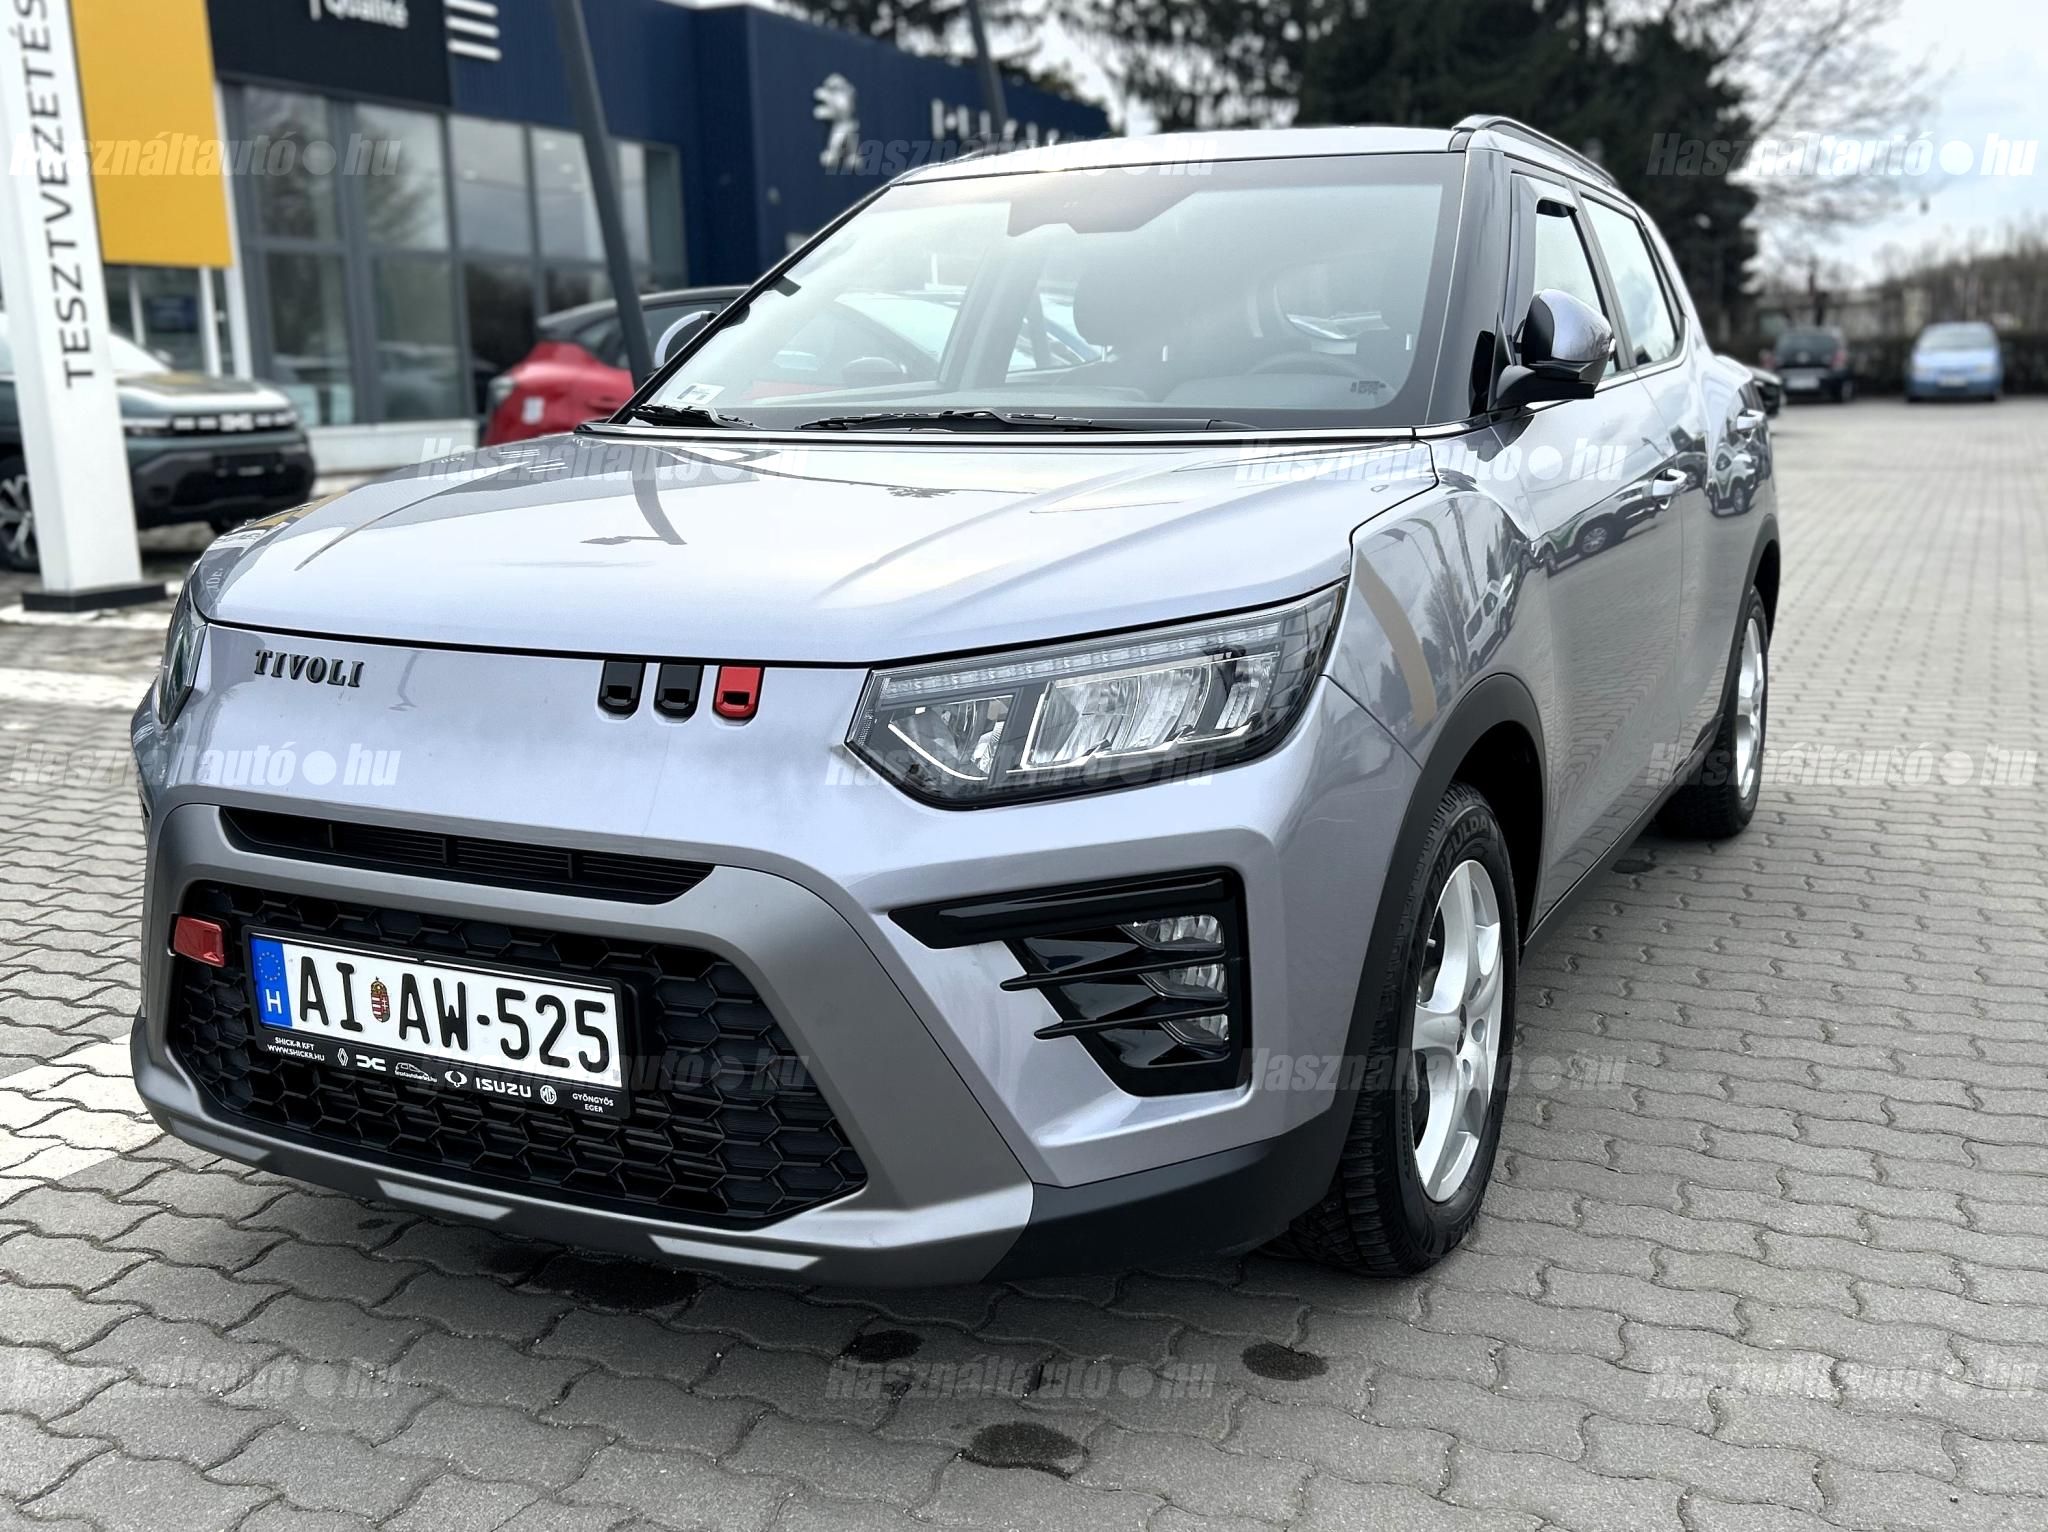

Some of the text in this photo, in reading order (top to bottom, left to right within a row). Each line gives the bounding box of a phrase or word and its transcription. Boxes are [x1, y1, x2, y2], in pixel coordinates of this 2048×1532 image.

[254, 649, 365, 688] TIVOLI
[265, 988, 283, 1015] H
[300, 956, 364, 1032] AI
[399, 973, 611, 1074] AW-525
[475, 1077, 532, 1098] ISUZU
[541, 1086, 557, 1104] MG
[572, 1092, 614, 1107] GYÖNGYÖS
[584, 1103, 604, 1113] EGER
